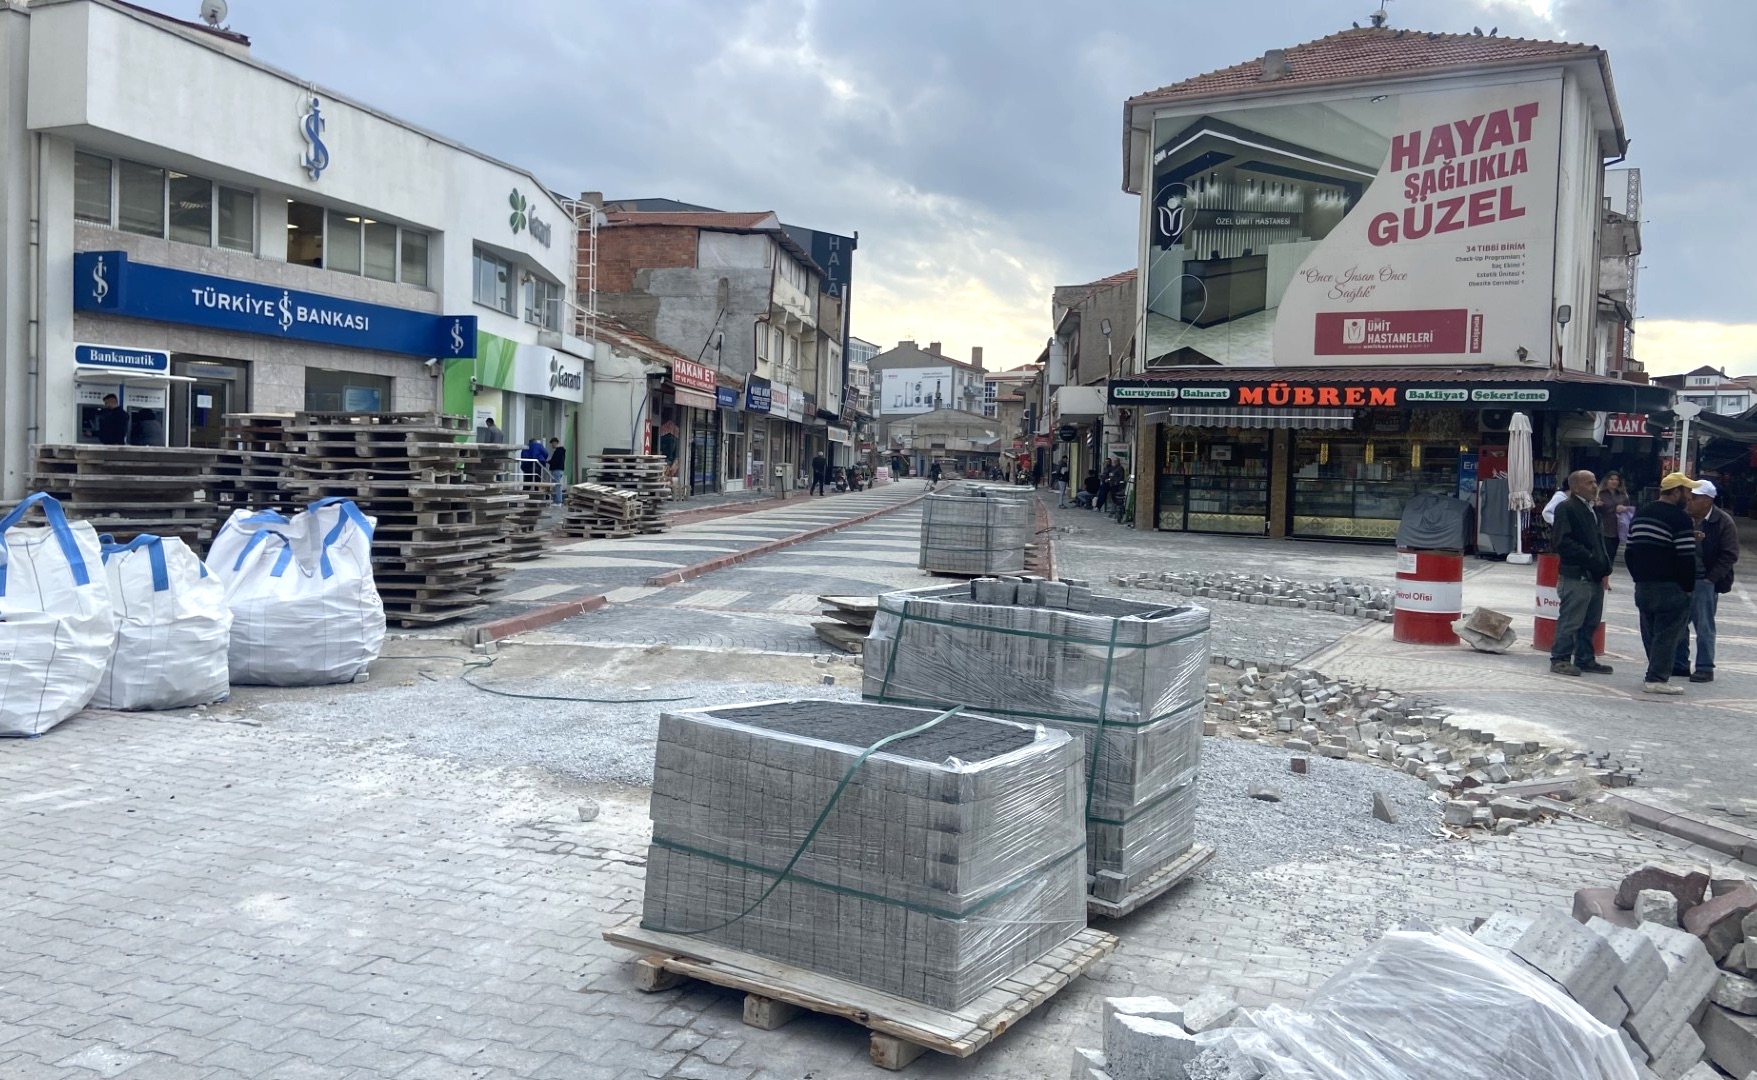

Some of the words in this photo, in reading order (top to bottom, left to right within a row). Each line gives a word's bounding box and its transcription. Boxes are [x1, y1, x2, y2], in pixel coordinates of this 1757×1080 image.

[1390, 101, 1539, 172] HAYAT
[1404, 147, 1528, 200] SAĞLIKLA
[1215, 216, 1233, 225] ÖZEL
[1235, 216, 1253, 225] ÜMİT
[1255, 215, 1291, 225] HASTANESİ
[1367, 185, 1526, 247] GÜZEL
[1466, 245, 1476, 253] 34
[1477, 243, 1499, 252] TIBBİ
[1500, 242, 1526, 251] BİRİM
[1379, 264, 1408, 282] Önce
[191, 286, 275, 317] TÜRKİYE
[296, 305, 369, 331] BANKASI
[1367, 319, 1391, 331] ÜMİT
[1367, 330, 1433, 343] HASTANELERİ
[90, 349, 155, 366] Bankamatik
[558, 364, 581, 390] Garanti
[674, 359, 703, 380] HAKAN
[704, 370, 715, 383] ET
[1115, 389, 1176, 399] Kuruyemiş
[1183, 389, 1228, 398] Baharat
[1237, 383, 1397, 406] MÜBREM
[1408, 390, 1465, 400] Bakliyat
[1474, 390, 1546, 400] Şekerleme
[1609, 419, 1639, 433] KAAN
[1412, 592, 1432, 601] Ofisi
[1544, 598, 1560, 607] Petr
